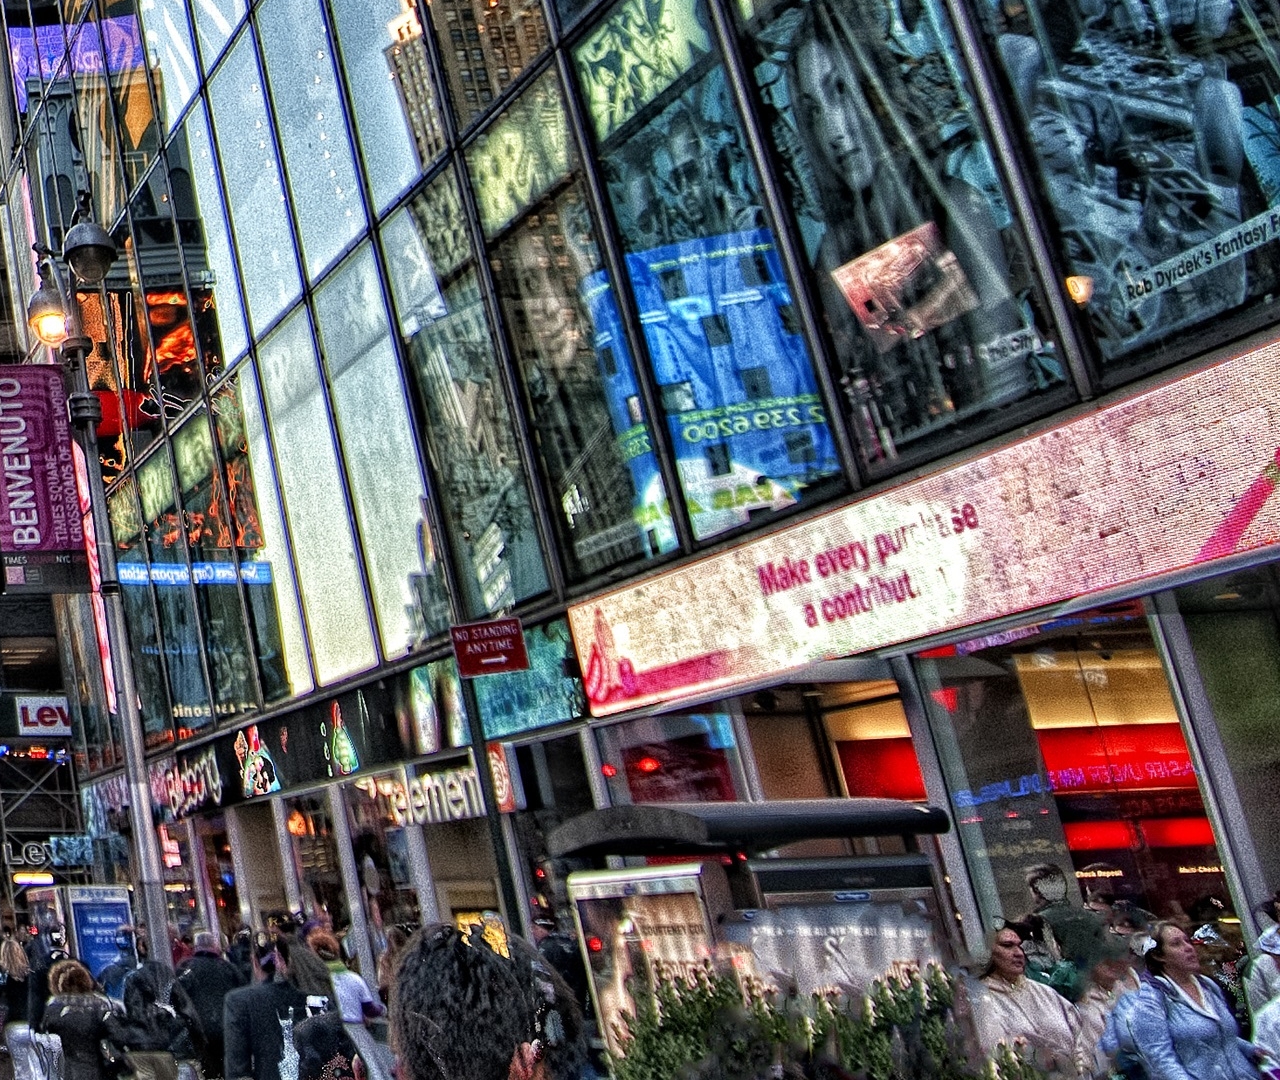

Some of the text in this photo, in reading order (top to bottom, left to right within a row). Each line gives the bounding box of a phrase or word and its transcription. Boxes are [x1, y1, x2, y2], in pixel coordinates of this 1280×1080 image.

[1126, 220, 1269, 300] Rob Dyrdek's Fantasy
[48, 375, 65, 413] WORLD
[53, 415, 69, 443] THE
[45, 454, 68, 544] TIMES SQUARE
[59, 464, 83, 543] CROSSROADS
[757, 555, 811, 597] Make
[814, 540, 870, 578] every
[803, 570, 922, 628] a contribut
[455, 622, 518, 642] NO STANDING
[465, 639, 515, 652] ANYTIME
[393, 747, 487, 827] element
[1097, 869, 1123, 878] Deposit
